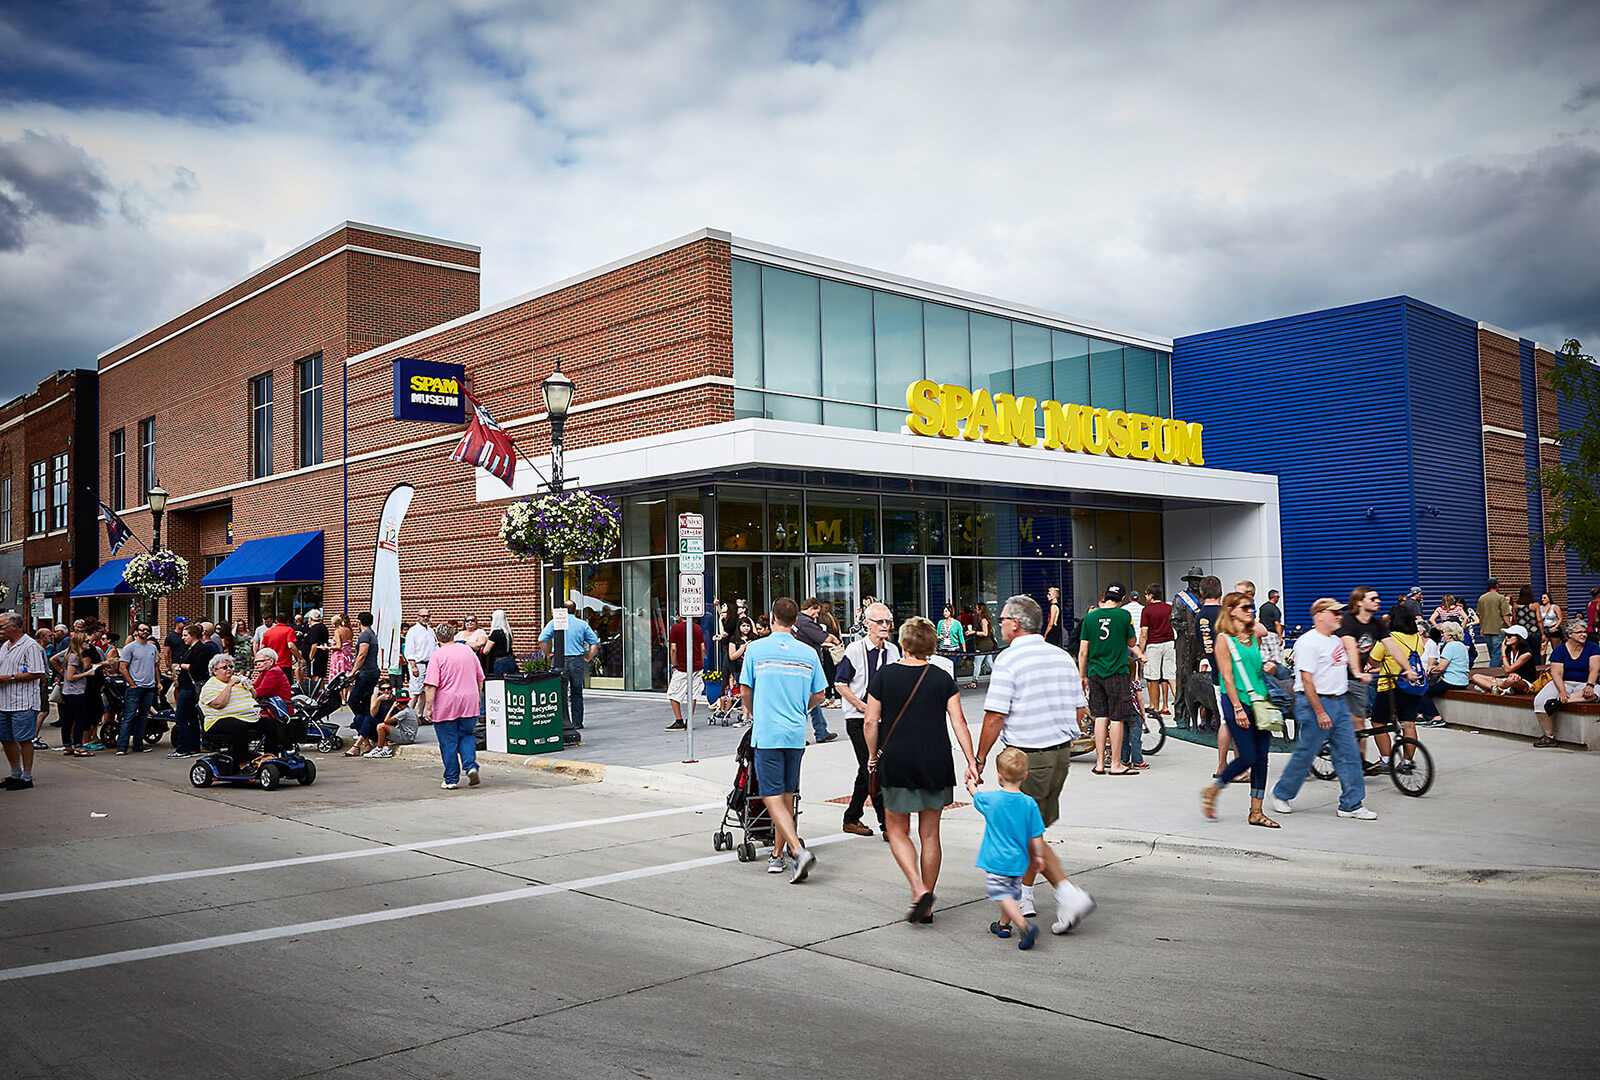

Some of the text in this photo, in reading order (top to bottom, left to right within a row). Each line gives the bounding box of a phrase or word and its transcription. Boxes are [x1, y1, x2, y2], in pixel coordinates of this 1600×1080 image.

[410, 376, 459, 394] SPAM
[411, 393, 458, 406] MUSEUM
[906, 380, 1205, 466] SPAM MUSEUM
[385, 528, 396, 543] 12
[681, 540, 687, 551] 2
[1099, 621, 1110, 640] 5
[531, 705, 558, 713] Recycling
